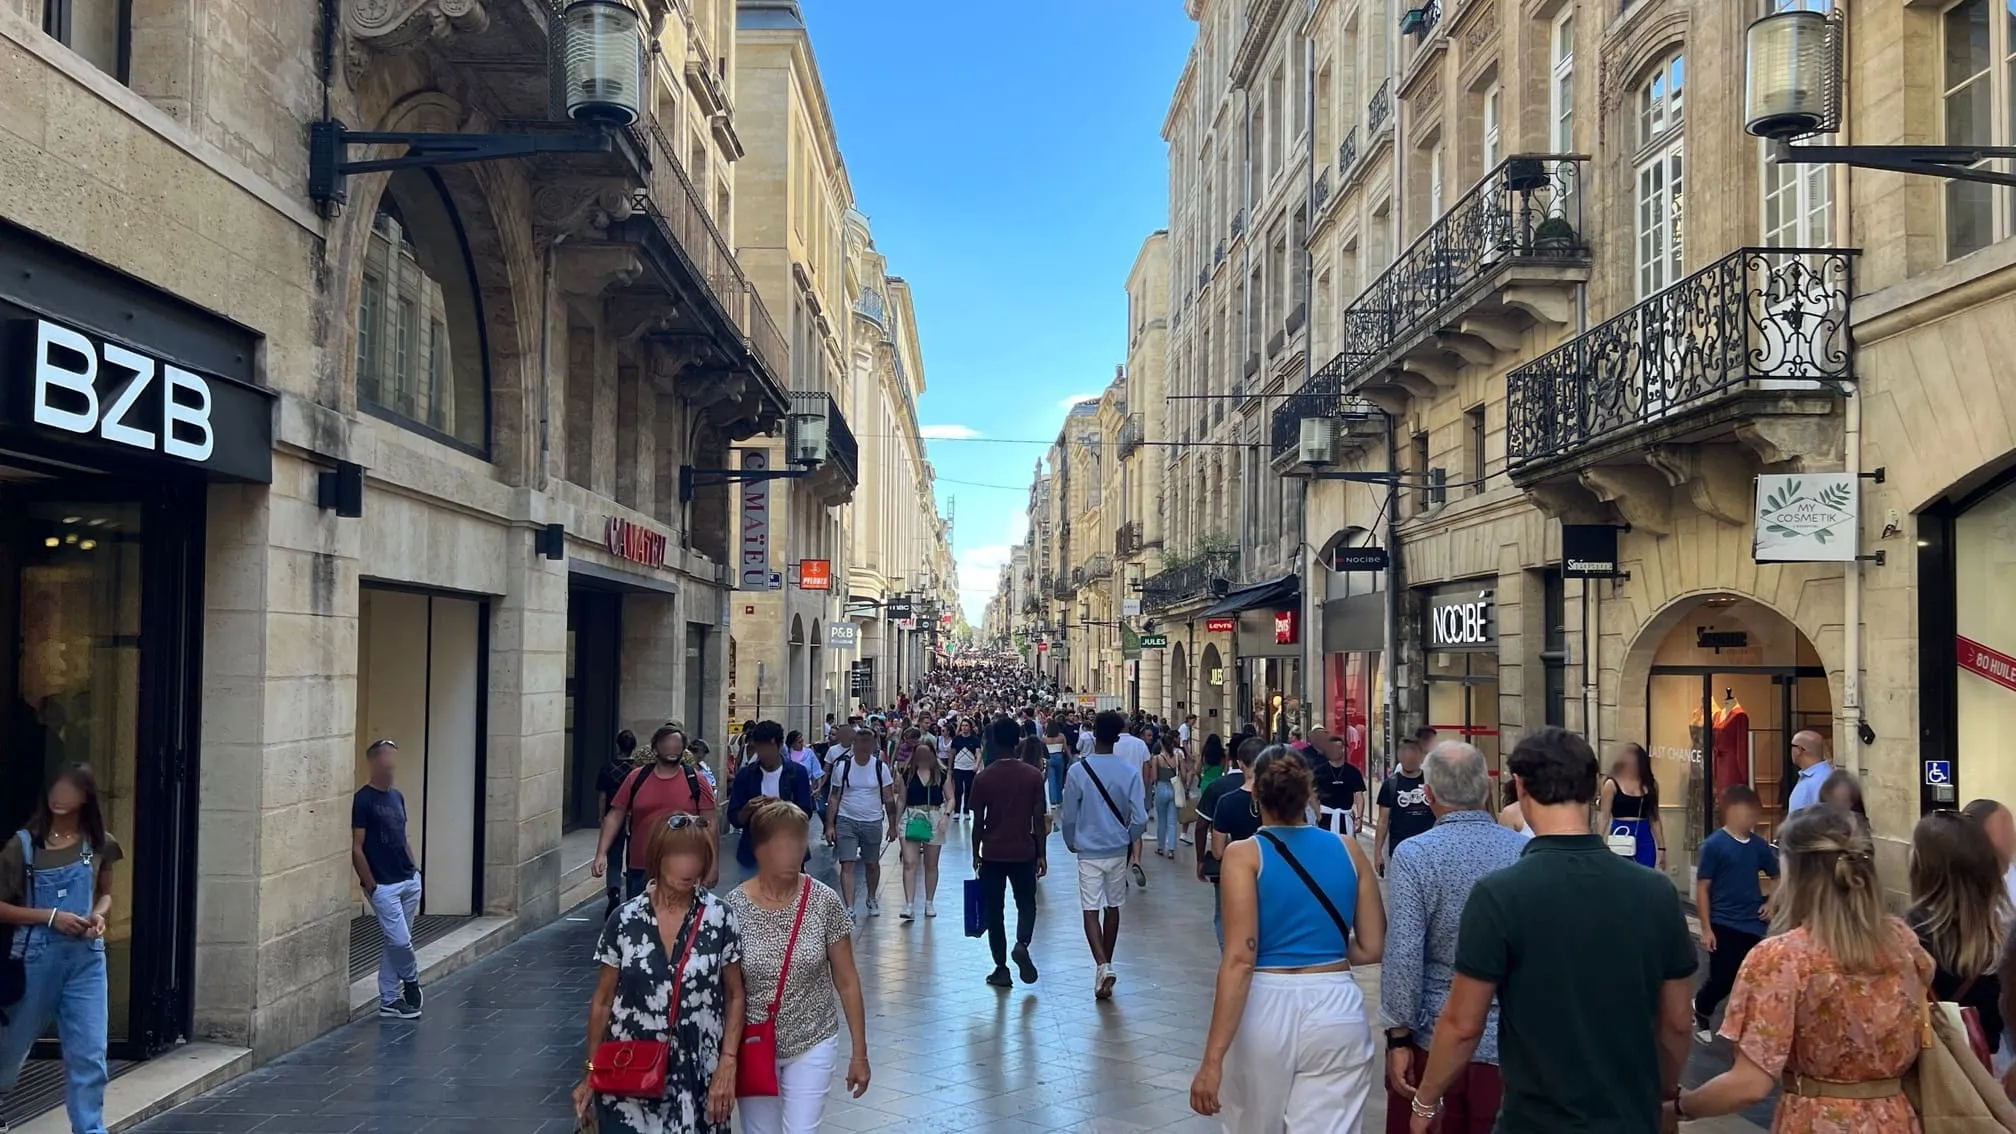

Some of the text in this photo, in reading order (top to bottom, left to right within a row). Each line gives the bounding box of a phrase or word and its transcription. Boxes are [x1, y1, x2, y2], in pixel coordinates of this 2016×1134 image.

[34, 319, 214, 462] BZB
[1797, 503, 1816, 512] MY
[1777, 513, 1837, 523] COSMETIK
[1433, 590, 1487, 643] NOCIBÉ
[831, 627, 853, 638] P&B
[1142, 638, 1166, 646] JULES
[1668, 747, 1702, 763] CHANCE
